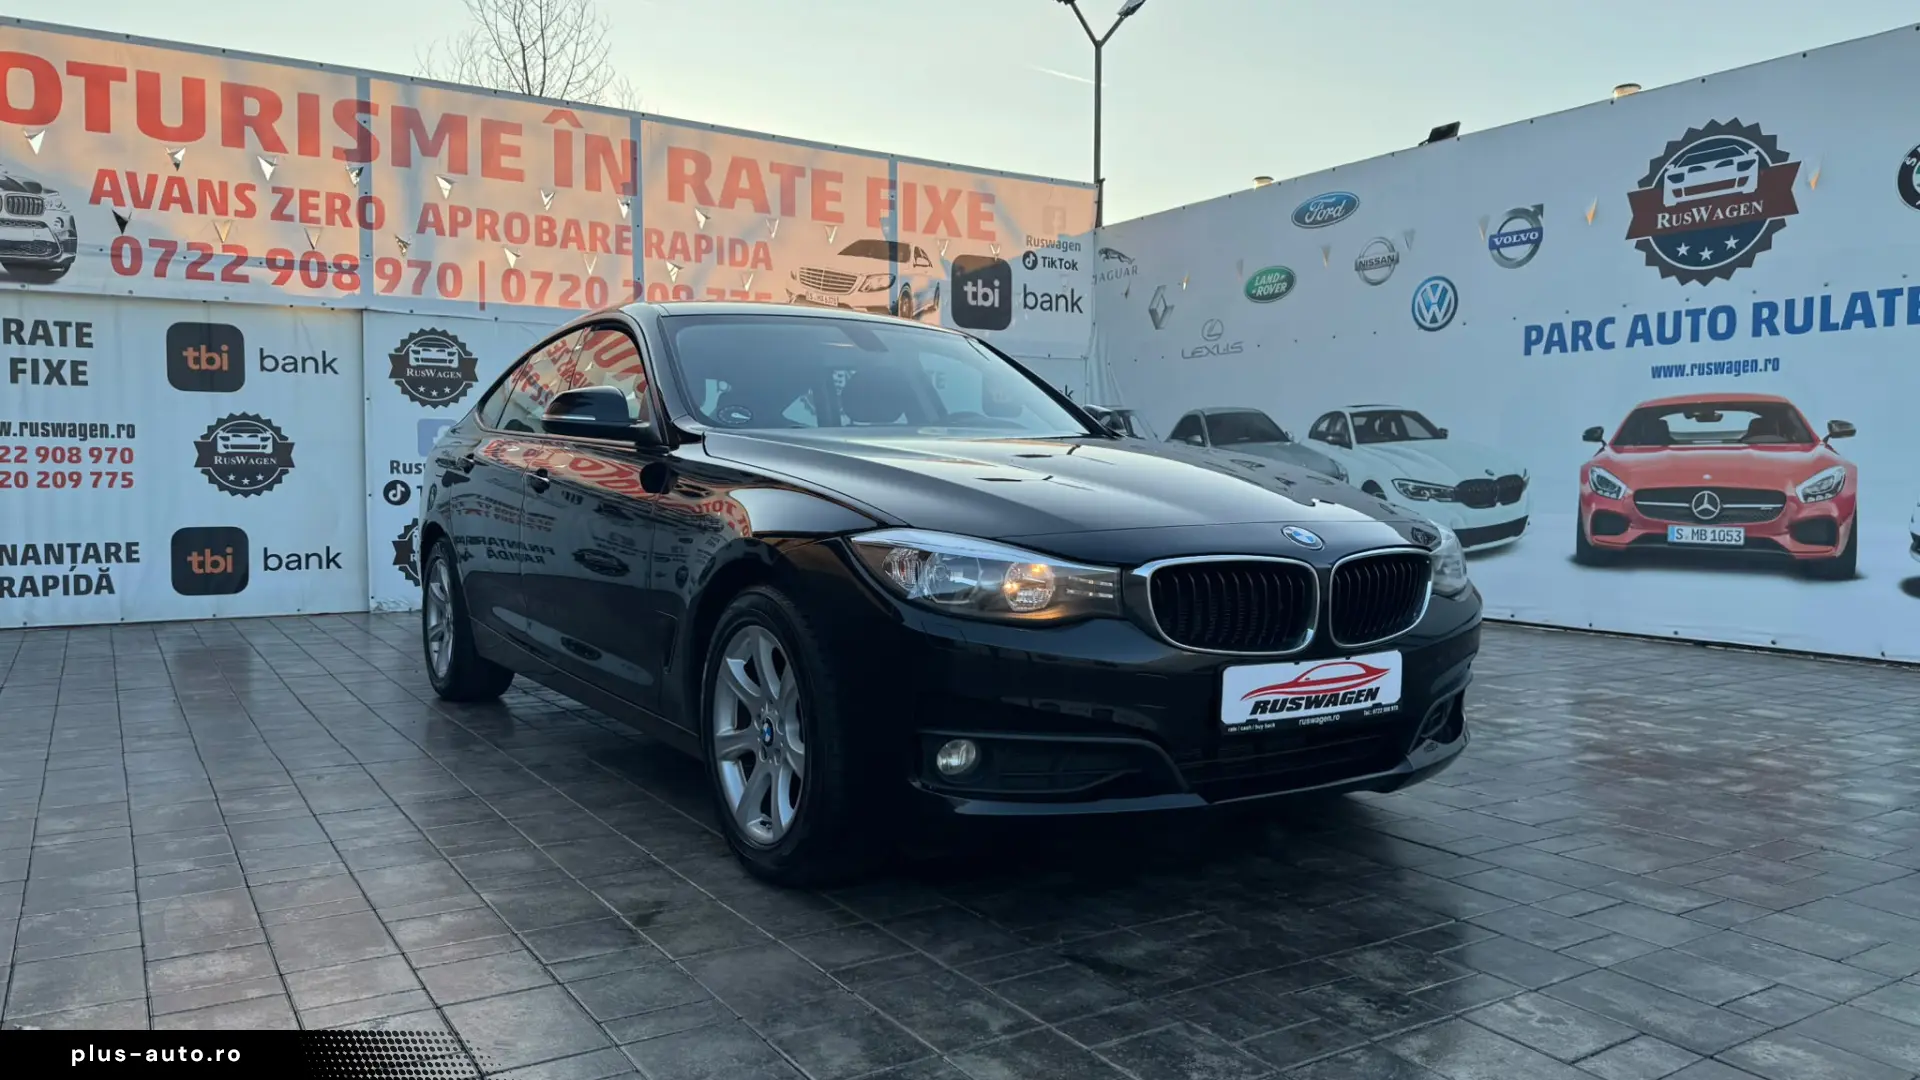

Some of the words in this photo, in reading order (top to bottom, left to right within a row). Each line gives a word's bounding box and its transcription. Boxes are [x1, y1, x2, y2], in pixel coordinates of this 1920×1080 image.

[0, 51, 525, 183] OTURISME
[542, 109, 638, 197] ÎN
[666, 146, 846, 224] RATE
[866, 175, 997, 242] FIXE
[89, 168, 258, 219] AVANS
[270, 186, 386, 231] ZERO
[416, 202, 632, 256] APROBARE
[644, 229, 773, 271] RAPIDA
[1304, 199, 1345, 224] Ford
[1025, 235, 1082, 253] Ruswagen
[1494, 230, 1539, 246] VOLVO
[1041, 256, 1079, 271] TikTok
[1358, 253, 1395, 268] NISSAN
[110, 236, 250, 284] 0722
[265, 247, 360, 292] 908
[374, 258, 463, 299] 970
[501, 268, 609, 309] 0720
[1254, 274, 1280, 287] LAND
[963, 279, 1000, 308] tbi
[1022, 284, 1084, 314] bank
[1255, 283, 1288, 297] ROVER
[2, 318, 94, 348] RATE
[1524, 317, 1616, 355] PARC
[1626, 305, 1737, 348] AUTO
[183, 343, 229, 372] tbi
[259, 348, 339, 375] bank
[1182, 341, 1244, 359] LEXUS
[9, 357, 89, 386] FIXE
[1651, 357, 1780, 379] www.ruswagen.ro
[0, 446, 28, 464] 22
[35, 446, 82, 464] 908
[89, 447, 134, 464] 970
[389, 460, 426, 475] Rus
[0, 471, 29, 488] 20
[36, 471, 82, 488] 209
[90, 471, 134, 489] 775
[1691, 529, 1708, 542] MB
[1710, 529, 1742, 542] 1053
[187, 547, 234, 574] tbi
[263, 546, 342, 572] bank
[1249, 687, 1381, 715] RUSWAGEN
[1299, 714, 1341, 726] ruswagen.ro
